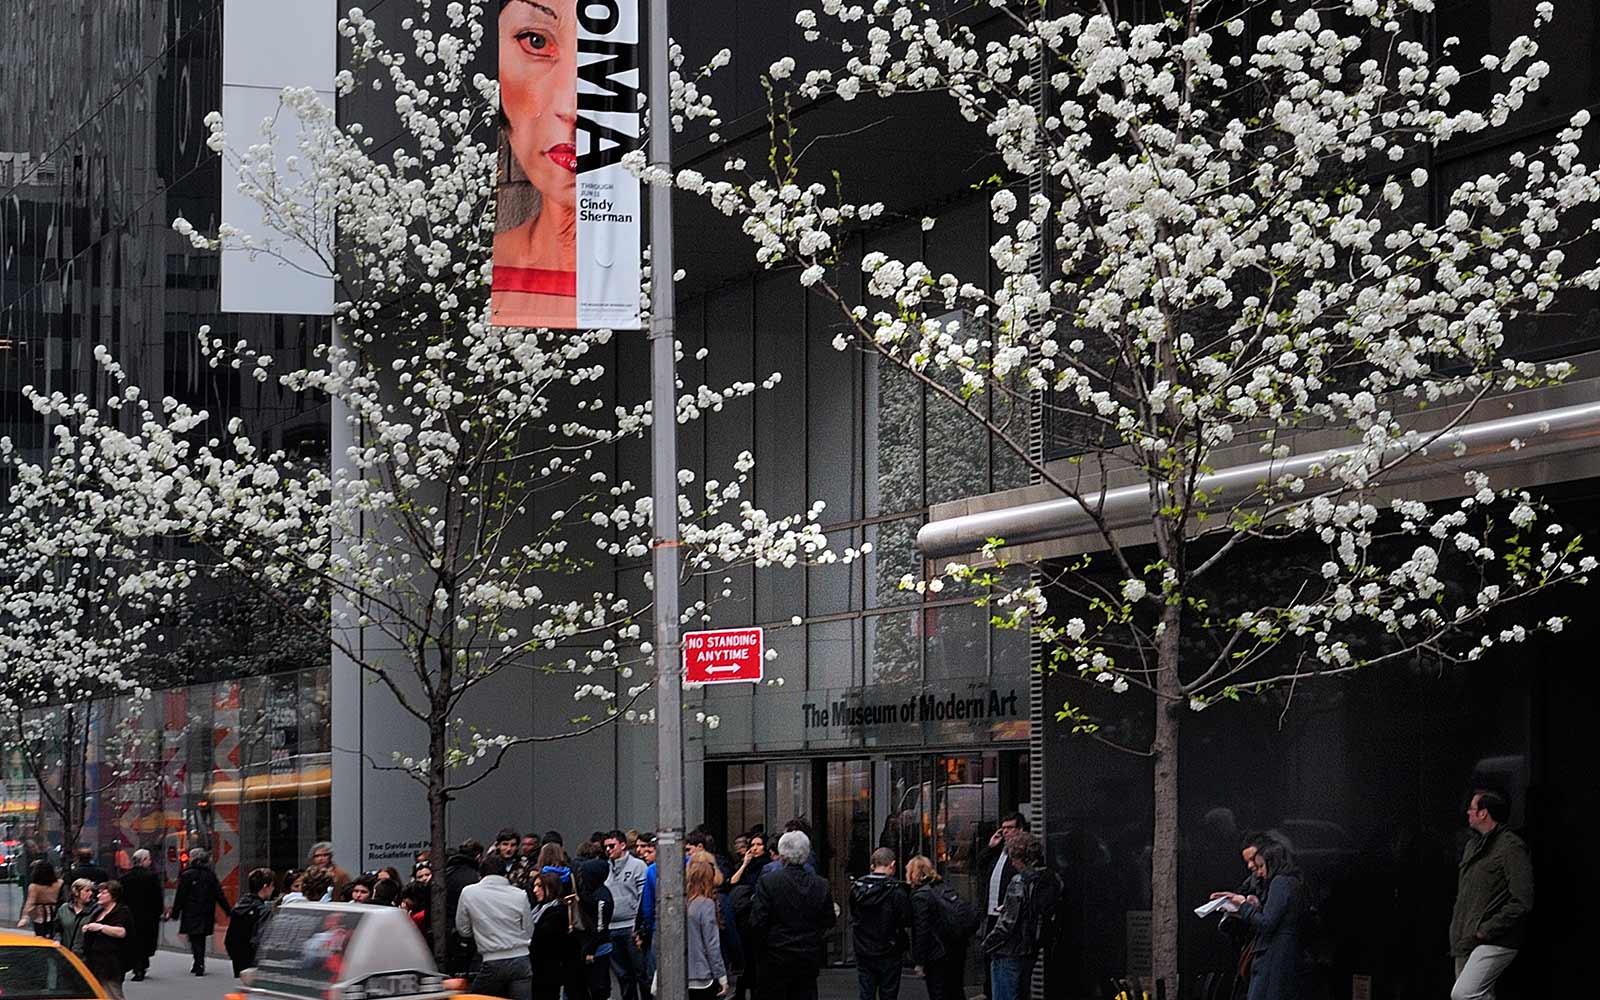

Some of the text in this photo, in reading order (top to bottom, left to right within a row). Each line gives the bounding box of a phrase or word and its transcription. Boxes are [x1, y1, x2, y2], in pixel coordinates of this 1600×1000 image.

[580, 198, 614, 212] Cindy
[580, 210, 633, 223] Sherman
[689, 634, 757, 649] NO STANDING
[697, 648, 749, 662] ANYTIME
[802, 689, 1018, 728] The Museum of Modern Art
[368, 842, 383, 850] The
[384, 841, 407, 850] David
[408, 841, 421, 849] and
